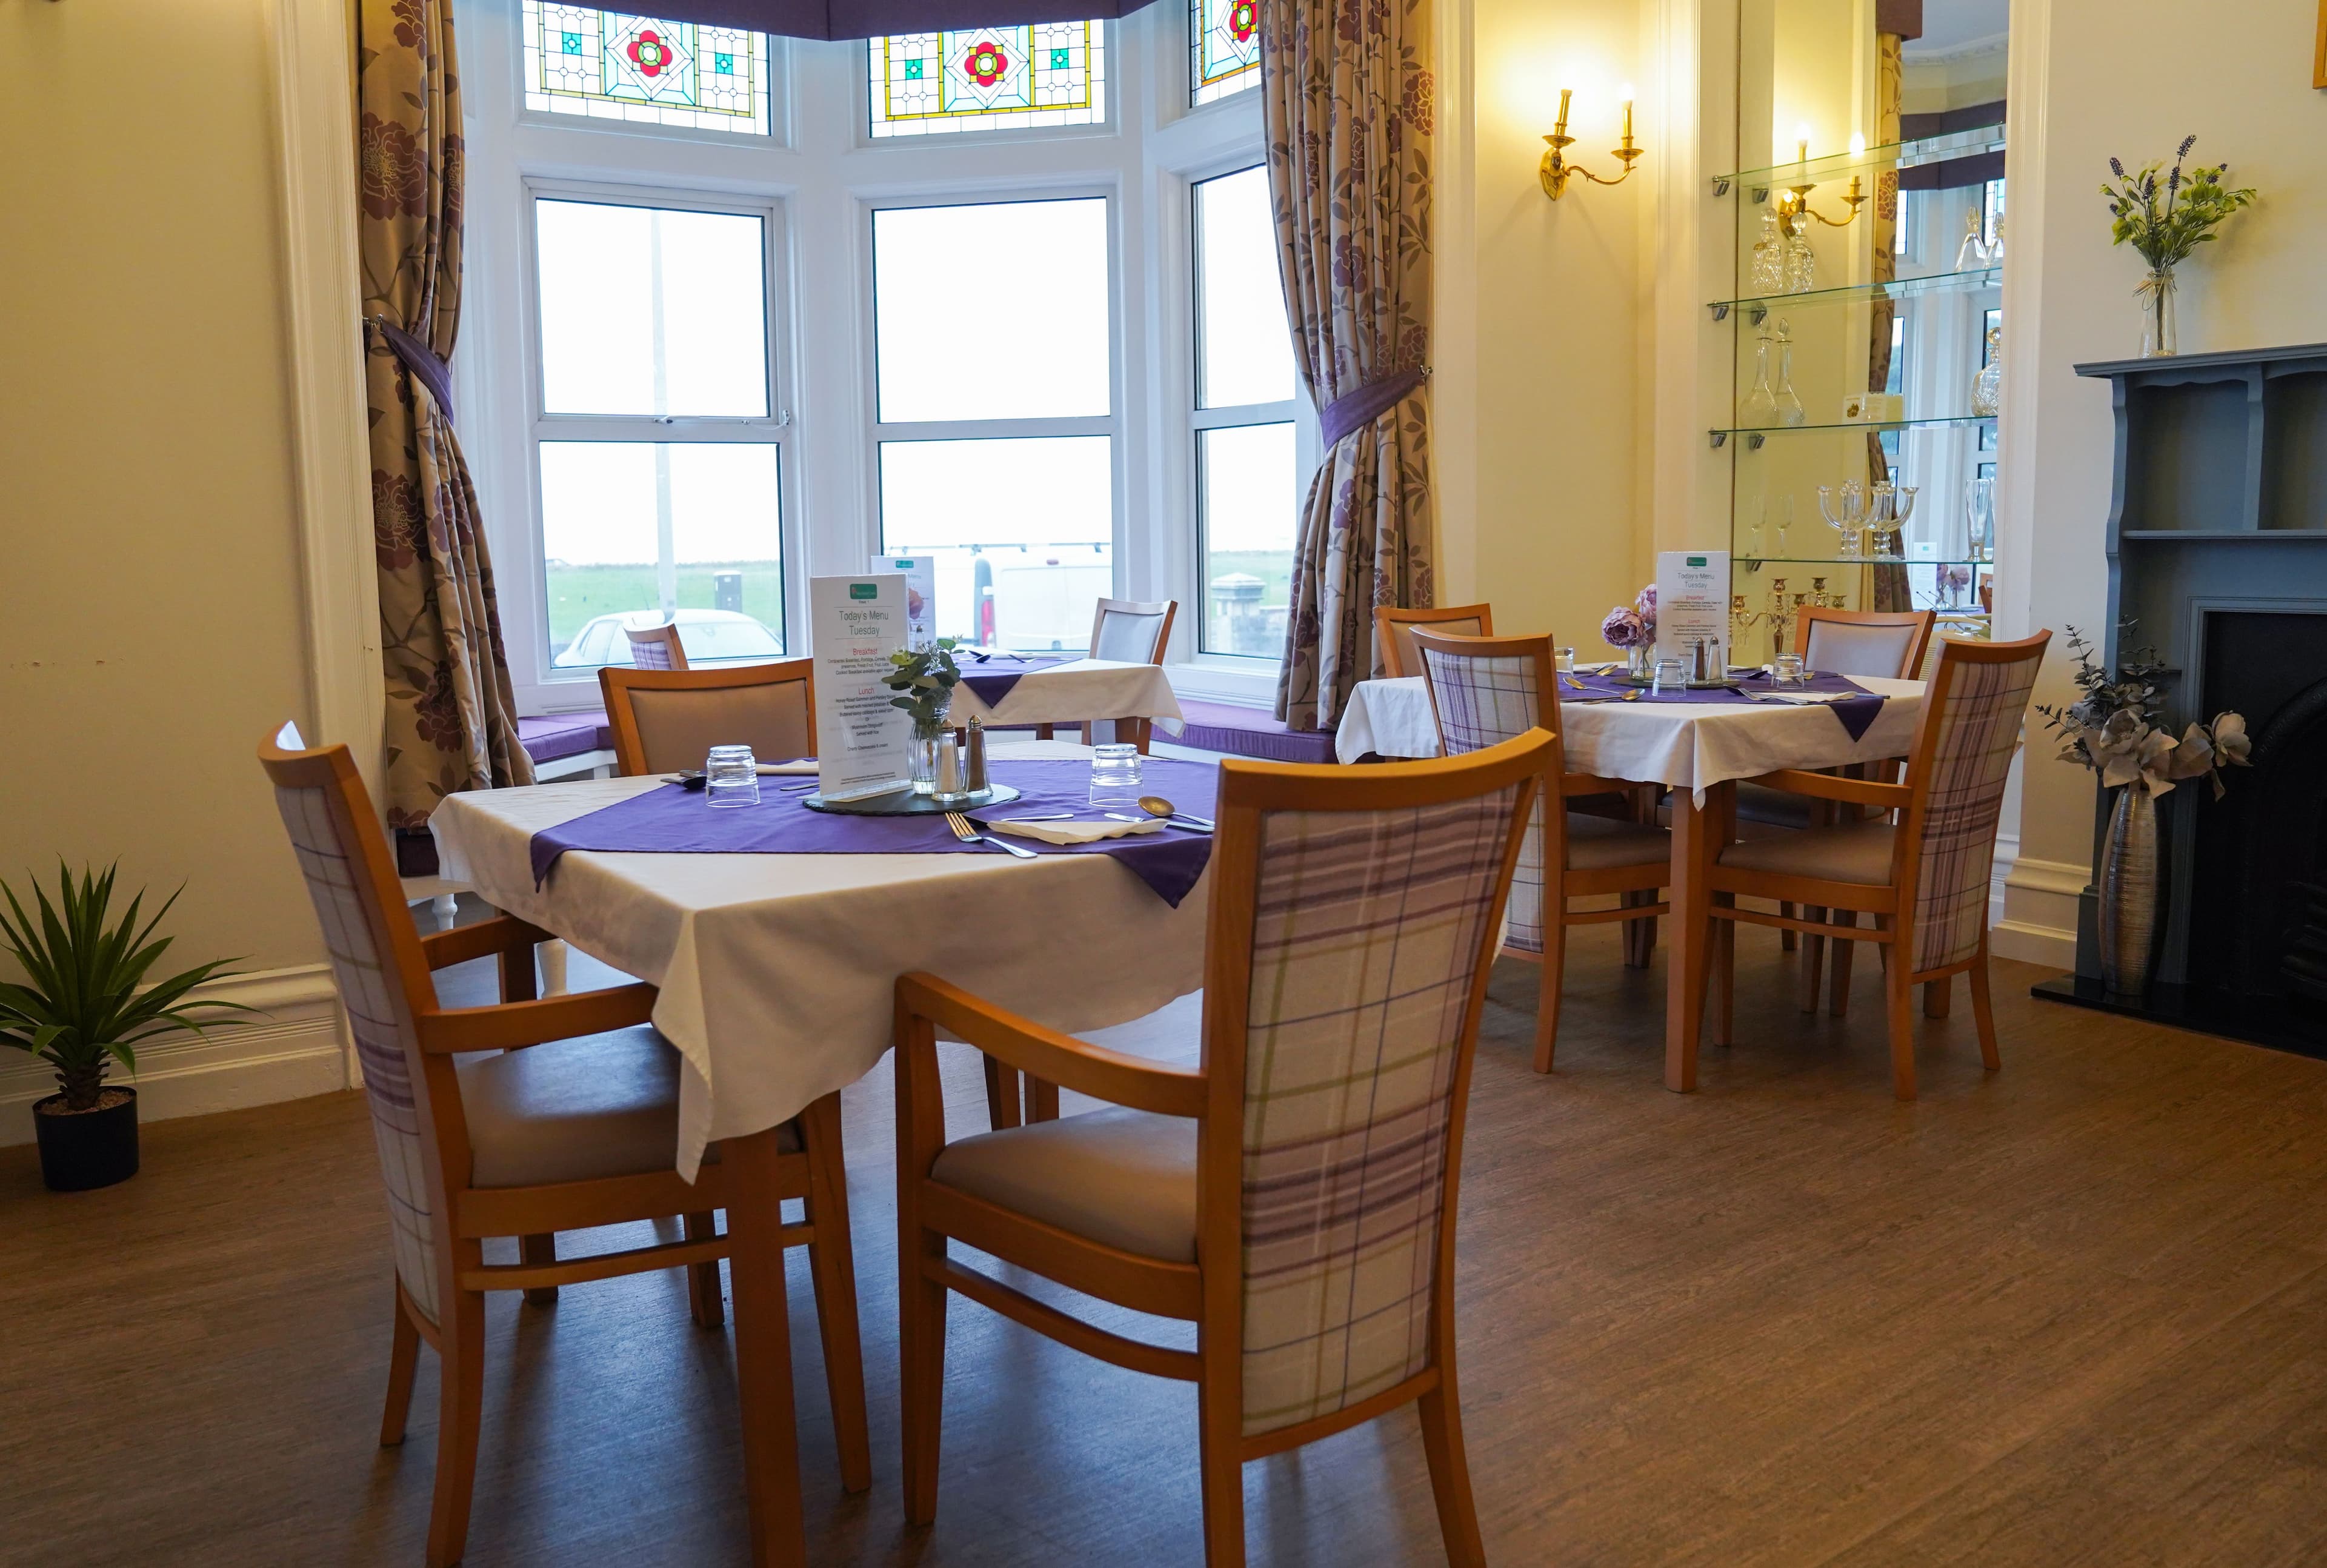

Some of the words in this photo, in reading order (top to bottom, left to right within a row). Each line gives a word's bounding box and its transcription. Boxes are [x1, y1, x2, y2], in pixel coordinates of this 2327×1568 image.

[1685, 581, 1707, 590] Tuesday
[839, 610, 867, 623] Today's
[869, 610, 888, 620] Menu
[849, 625, 880, 637] Tuesday
[858, 686, 874, 695] Lunch
